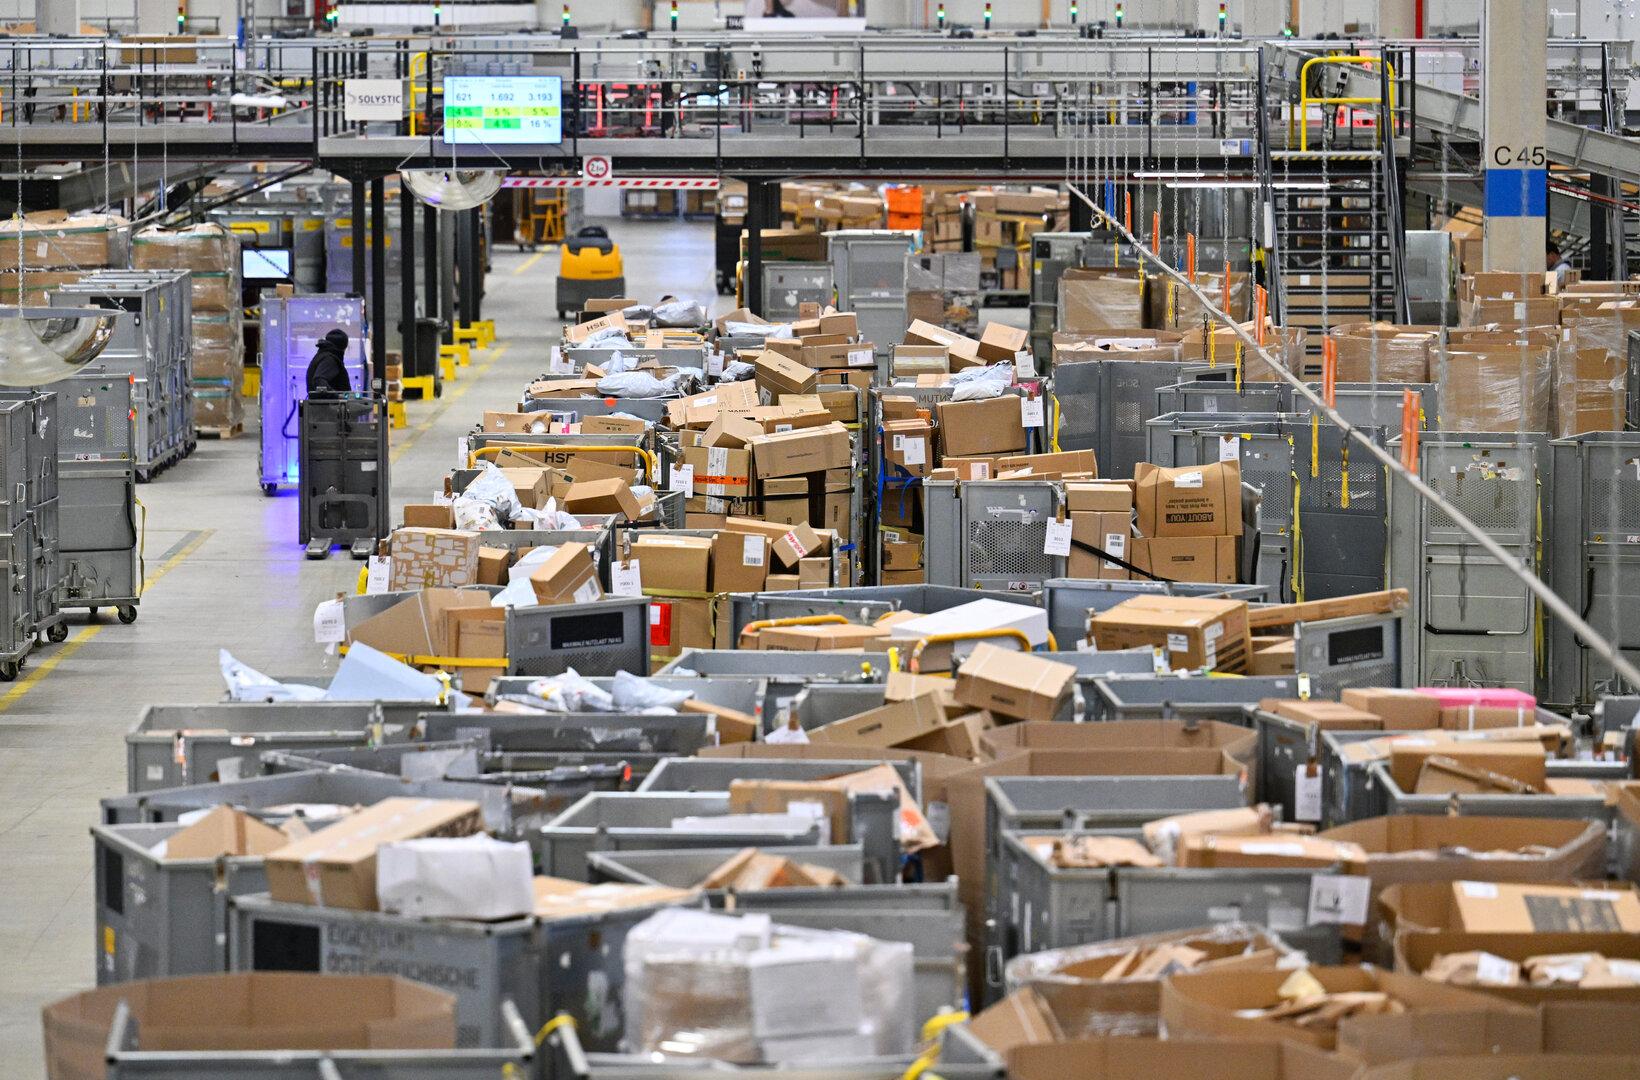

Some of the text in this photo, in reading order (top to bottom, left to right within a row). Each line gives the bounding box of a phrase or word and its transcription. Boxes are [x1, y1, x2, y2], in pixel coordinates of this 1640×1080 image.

[358, 95, 400, 104] SOLYSTIC
[456, 92, 472, 102] 621
[491, 92, 514, 102] 1.692
[528, 92, 553, 102] 3.193
[1494, 146, 1545, 166] C 45
[586, 319, 608, 332] HSE
[1188, 513, 1213, 521] ABOUT
